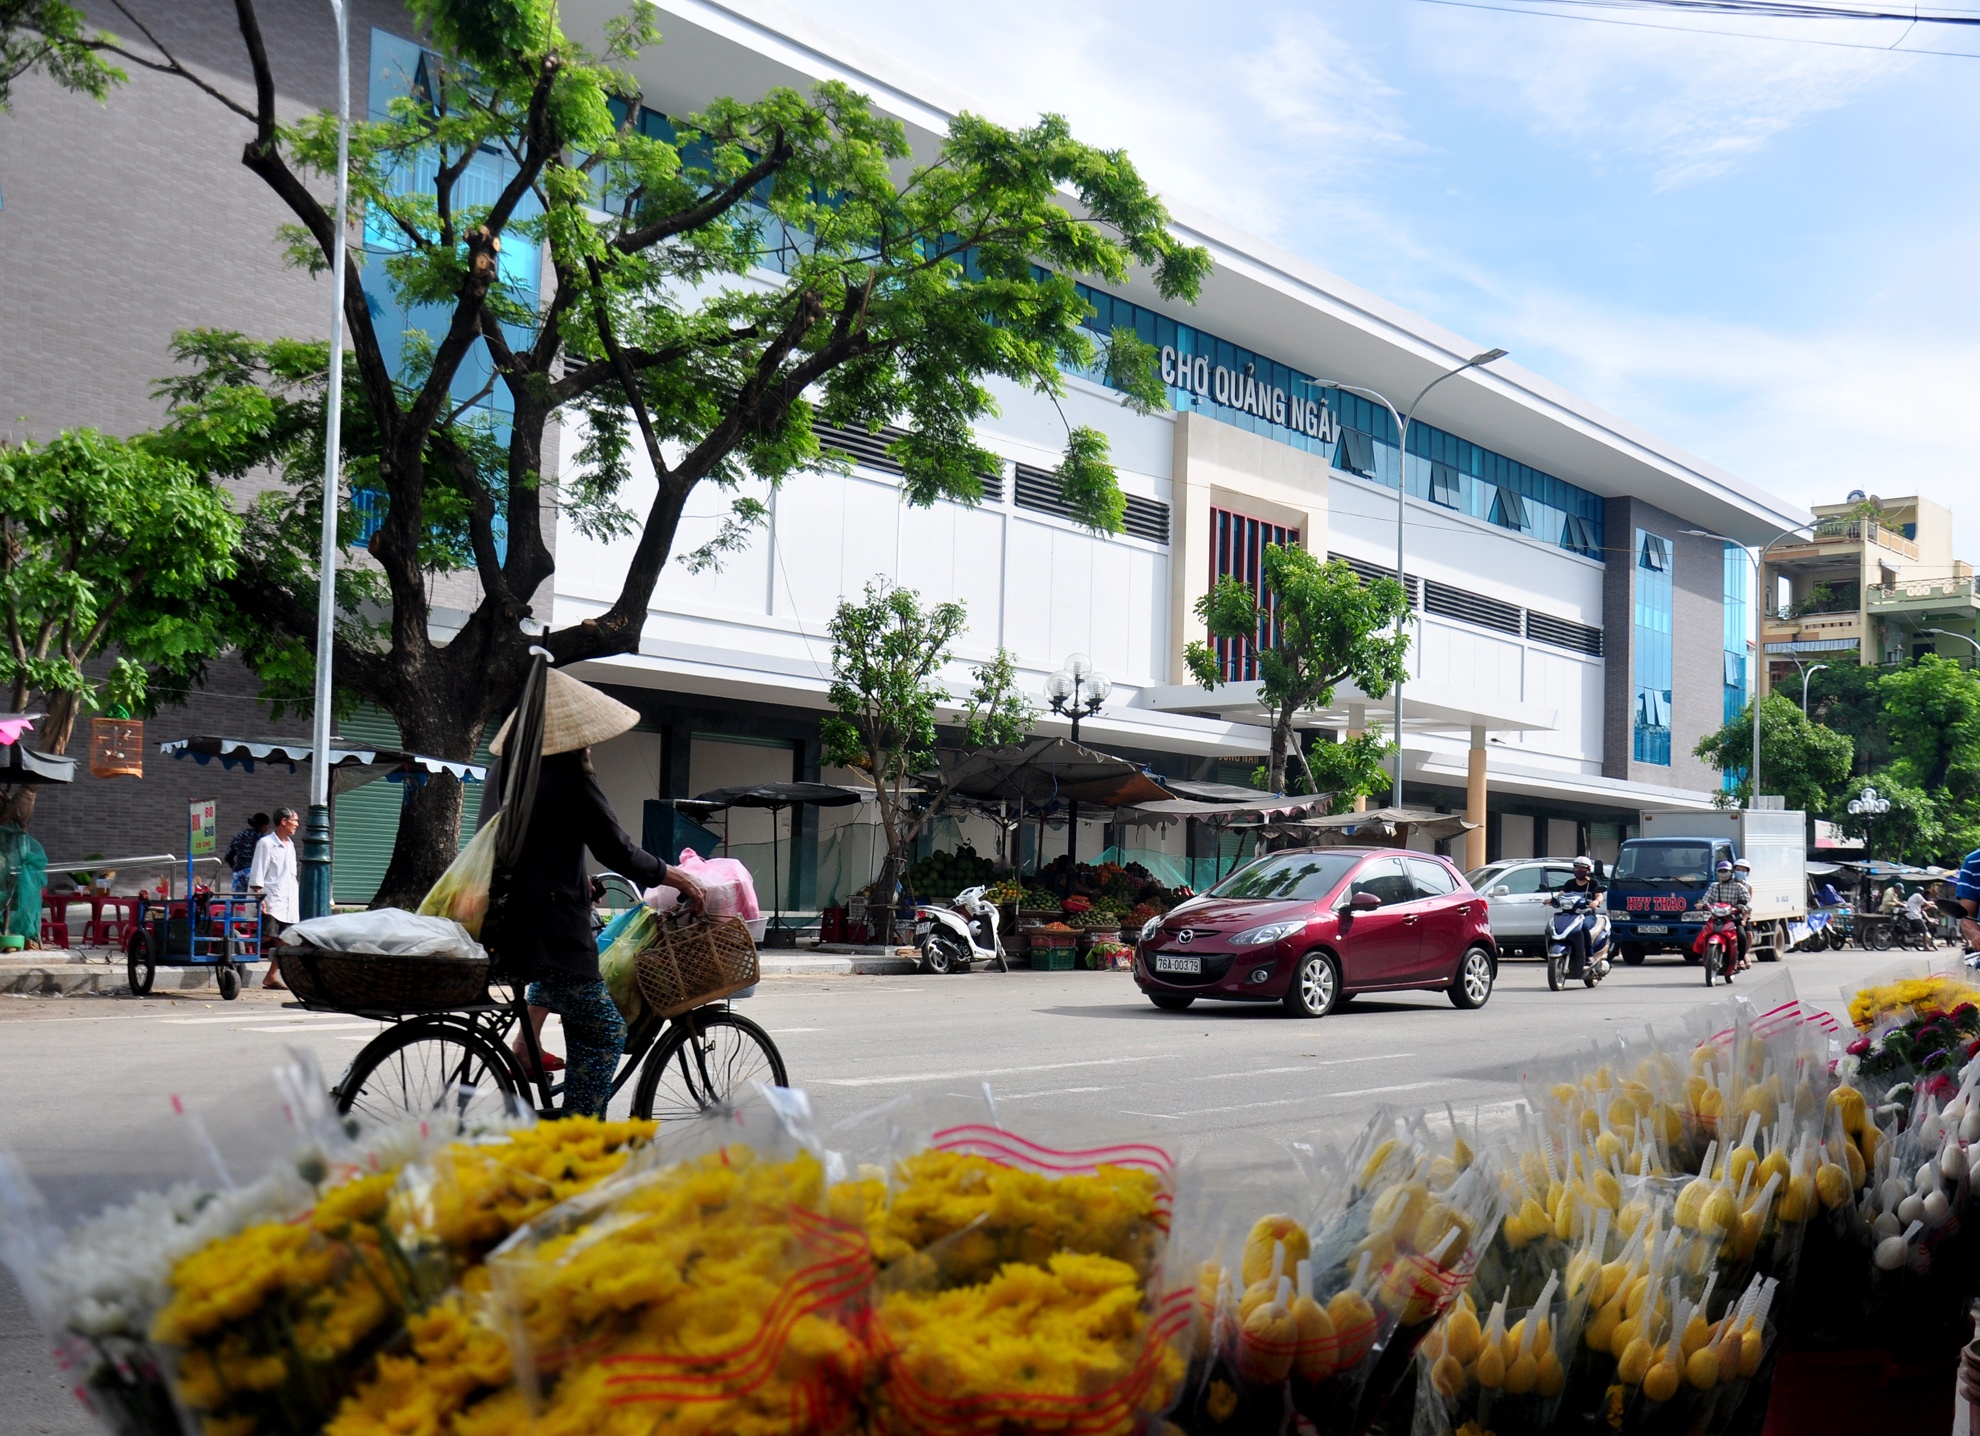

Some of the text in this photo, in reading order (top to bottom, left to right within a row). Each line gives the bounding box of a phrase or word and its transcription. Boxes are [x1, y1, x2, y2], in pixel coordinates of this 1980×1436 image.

[1161, 344, 1338, 443] CHỢ QUẢNG NGÃI
[1626, 892, 1687, 912] HUY THẢO
[1157, 958, 1199, 971] 76A-003.79
